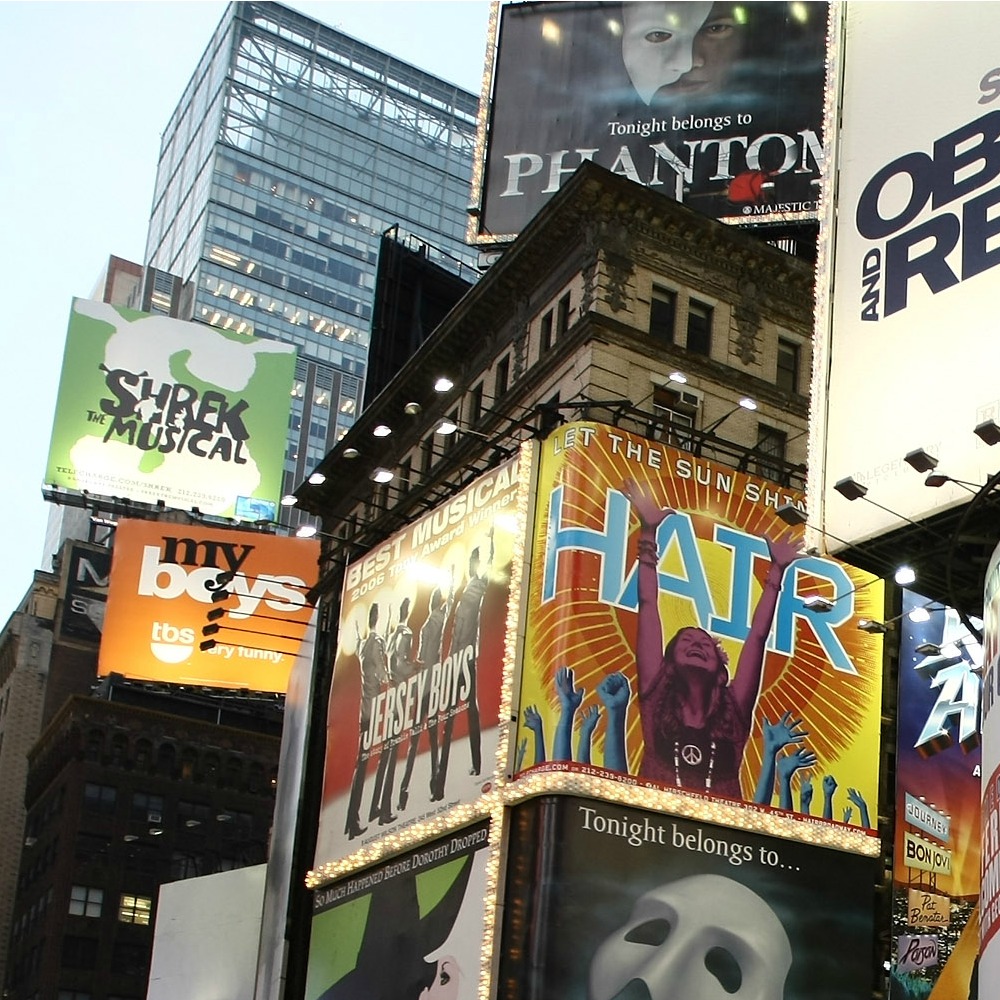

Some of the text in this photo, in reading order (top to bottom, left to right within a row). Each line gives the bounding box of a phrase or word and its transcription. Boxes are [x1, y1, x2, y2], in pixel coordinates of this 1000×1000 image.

[608, 112, 753, 137] Tonight belongs to
[753, 201, 811, 215] MAJESTIC
[861, 247, 882, 322] AND
[99, 363, 250, 441] SHREK
[86, 409, 248, 465] THE MUSICAL
[553, 426, 733, 493] LET THE SUN
[347, 461, 521, 591] BEST MUSICAL
[350, 489, 518, 603] 2006 Award Winner
[138, 545, 307, 620] boys
[160, 536, 255, 591] my
[541, 484, 859, 676] HAIR
[152, 621, 195, 643] tbs
[202, 643, 235, 660] ery
[363, 644, 474, 751] JERSEY BOYS
[579, 806, 801, 872] Tonight belongs to...
[906, 802, 947, 835] JOURNEY
[906, 839, 951, 871] BON JOVI
[911, 907, 949, 926] Benatar
[921, 894, 937, 912] Pat
